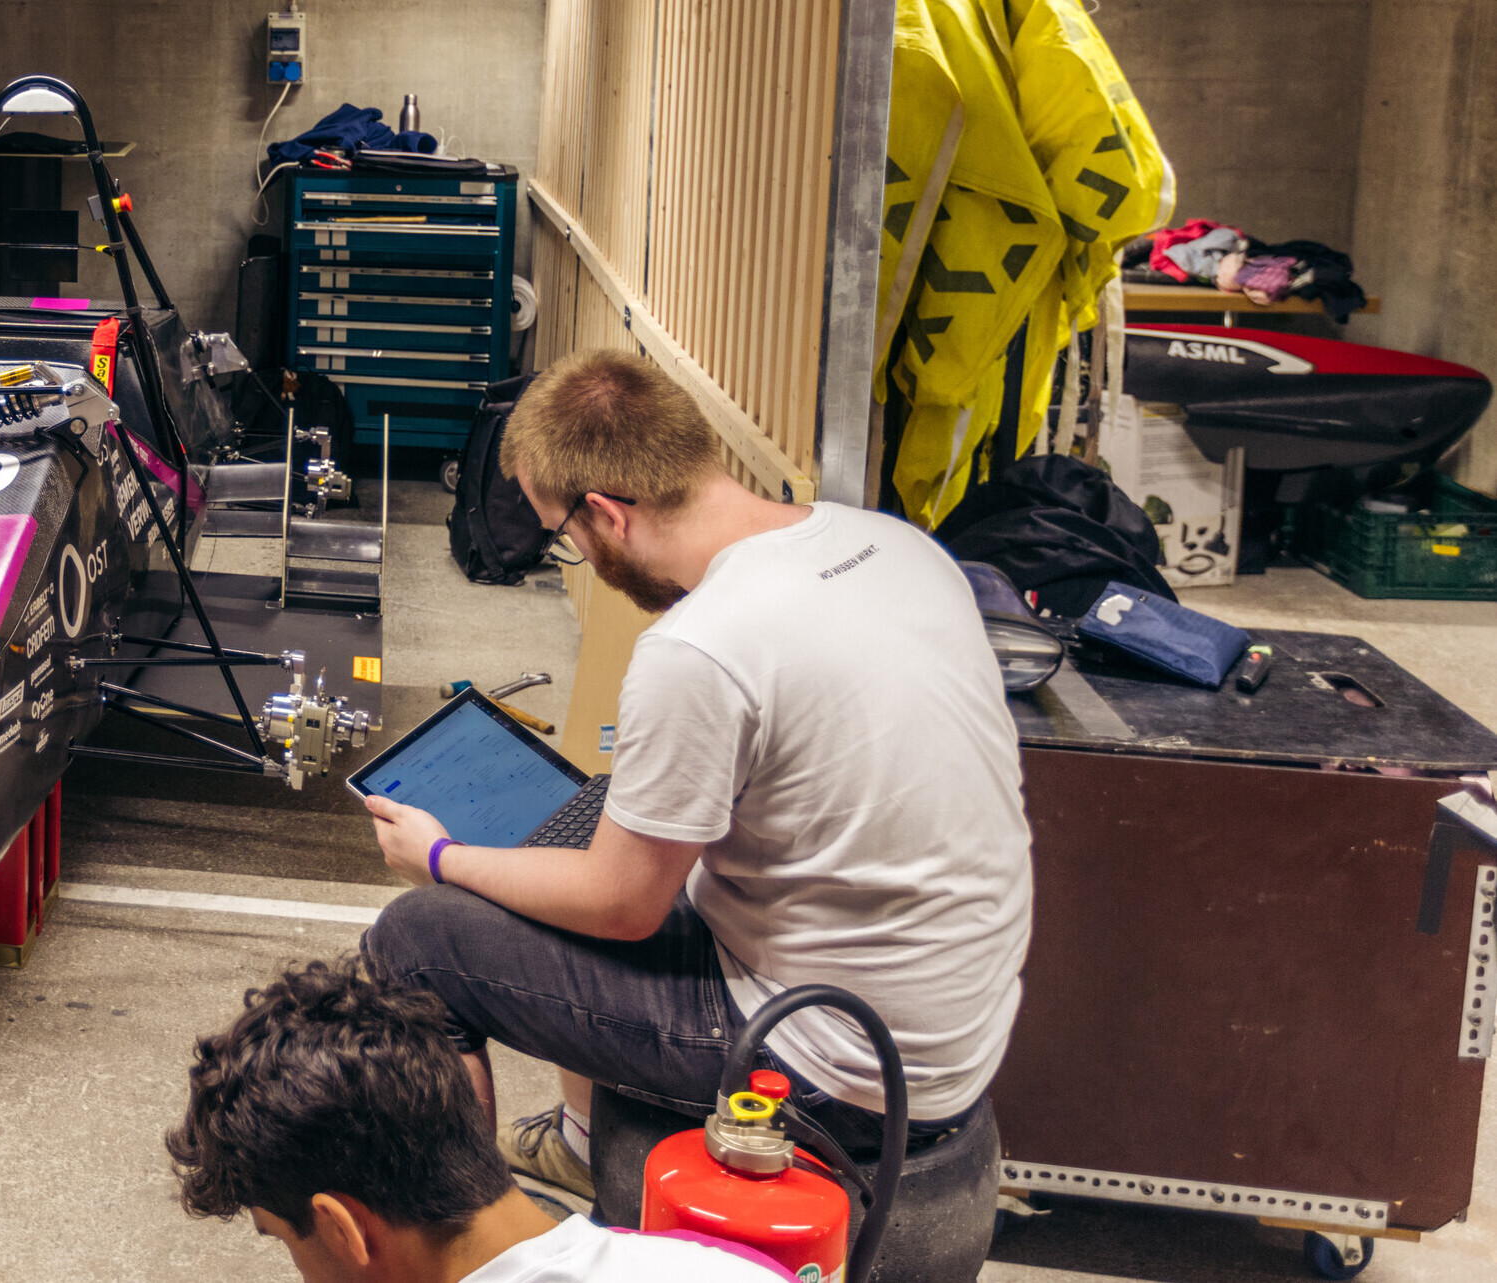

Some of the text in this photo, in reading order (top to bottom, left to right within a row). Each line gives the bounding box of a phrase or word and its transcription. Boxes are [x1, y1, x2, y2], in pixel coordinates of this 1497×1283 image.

[1167, 340, 1246, 364] ASML
[87, 539, 108, 583] OST
[818, 544, 880, 580] WO WISSEN WIRKT.
